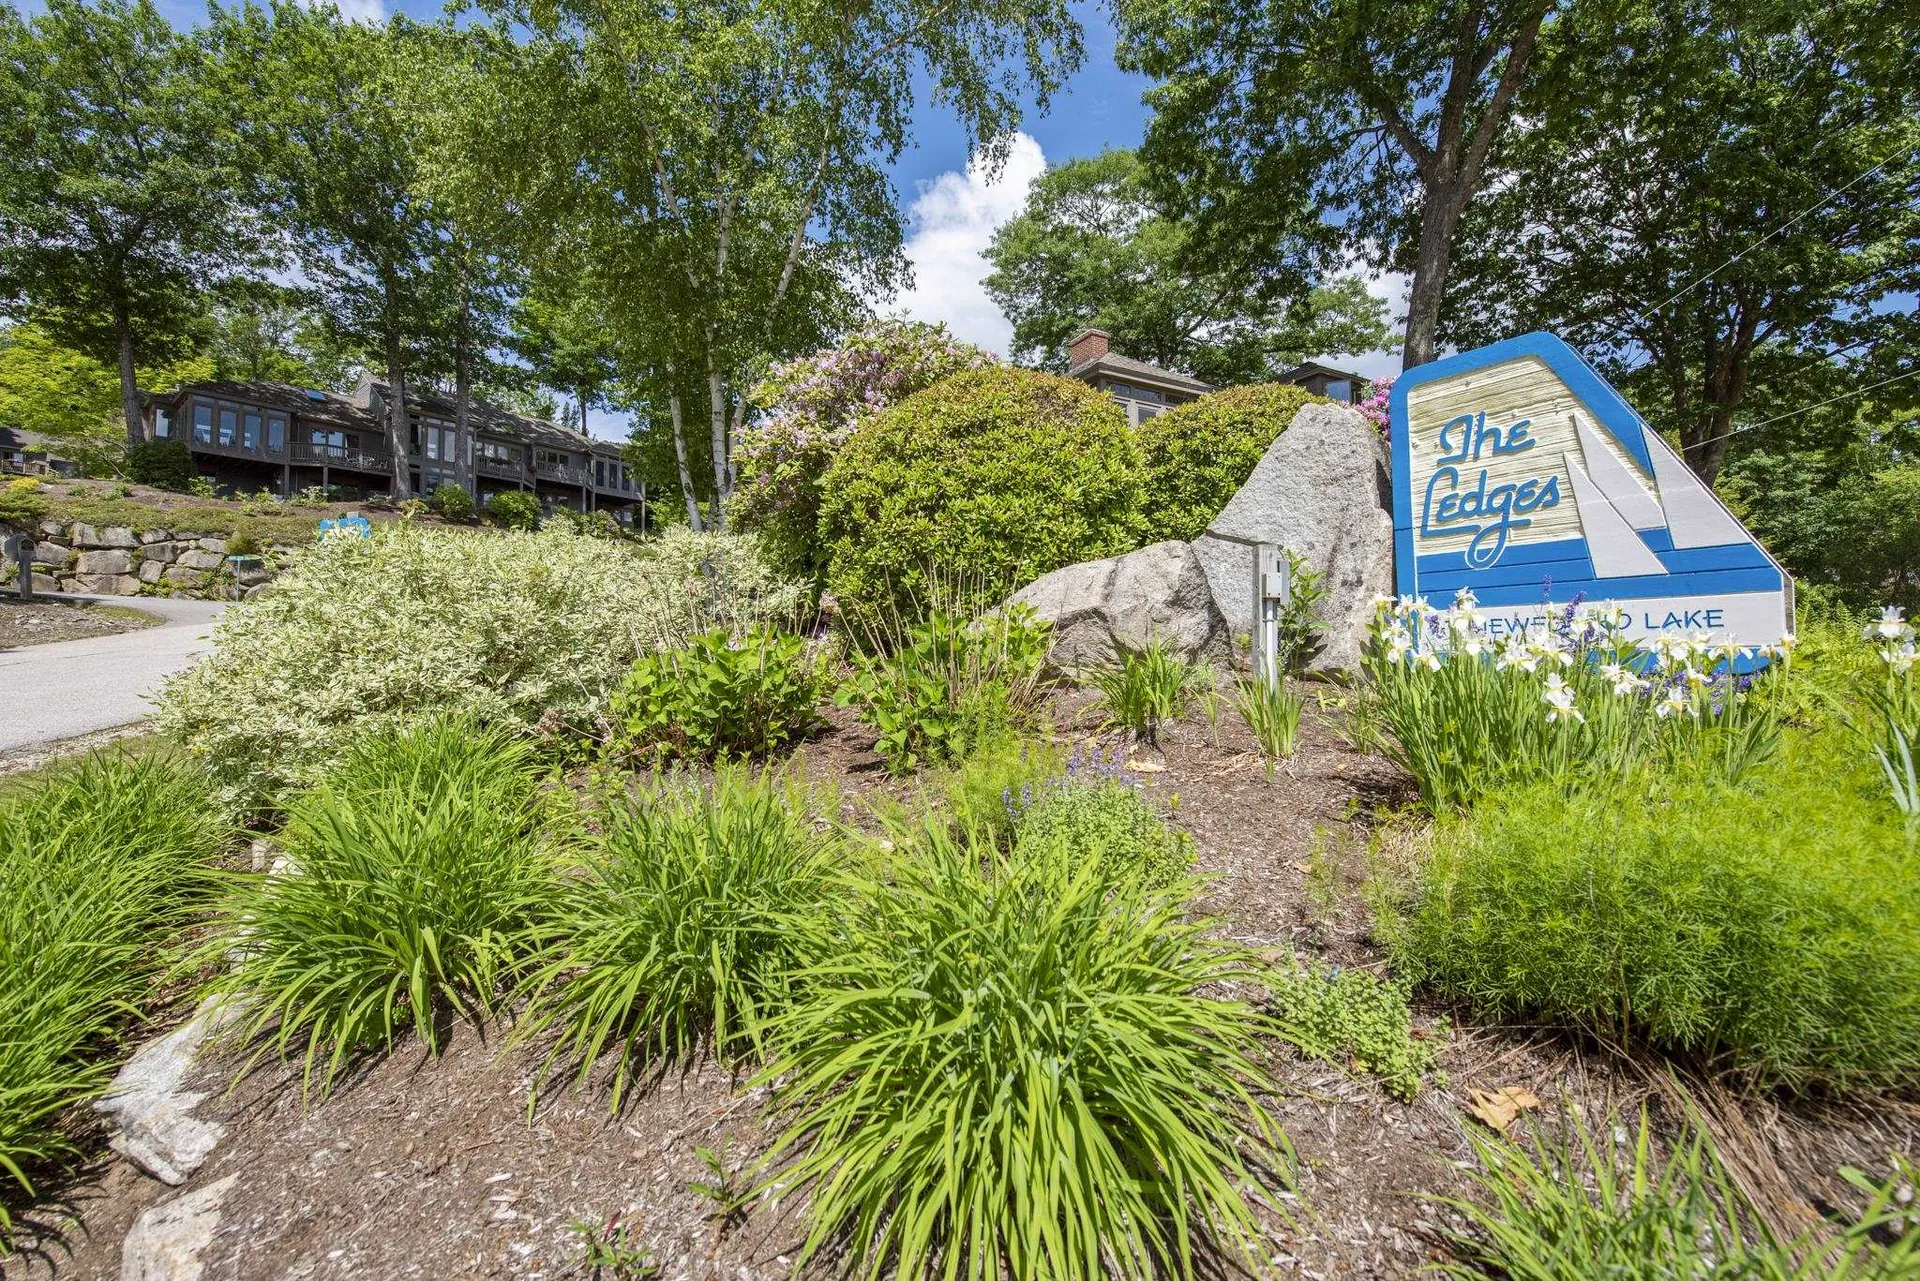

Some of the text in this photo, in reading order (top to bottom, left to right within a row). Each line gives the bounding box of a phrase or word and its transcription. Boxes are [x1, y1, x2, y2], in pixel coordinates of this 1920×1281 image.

[1437, 411, 1536, 465] The
[1420, 466, 1560, 569] Ledges
[1644, 609, 1725, 629] LAKE
